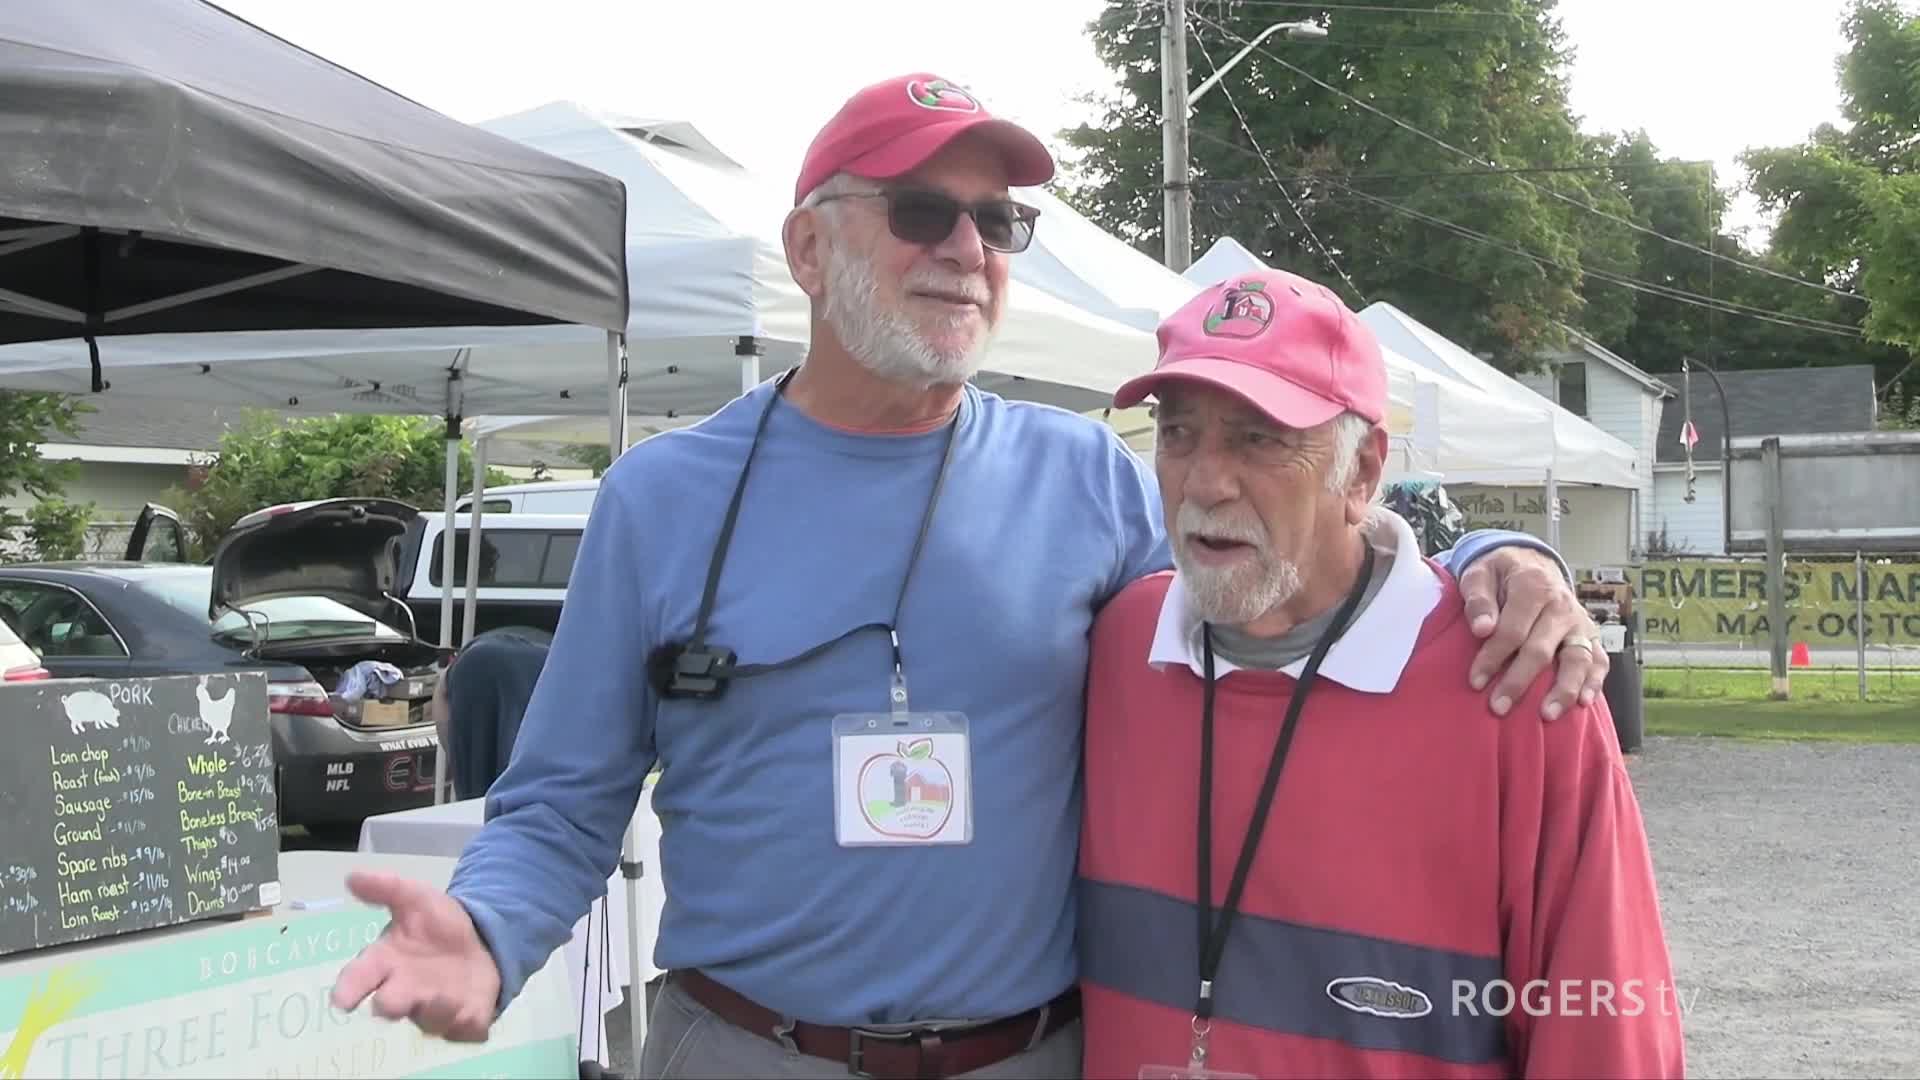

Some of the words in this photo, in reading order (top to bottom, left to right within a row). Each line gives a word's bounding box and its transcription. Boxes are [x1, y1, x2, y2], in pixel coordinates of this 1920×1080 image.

[1512, 490, 1571, 515] Laks
[1620, 567, 1812, 602] ARMERS'
[109, 682, 153, 705] PORK
[81, 742, 109, 771] chop
[326, 762, 354, 776] MLB
[52, 768, 89, 791] Roast
[326, 779, 351, 792] NFL
[54, 793, 113, 823] Sausage
[179, 808, 226, 832] Boneless
[227, 800, 264, 825] Breast
[53, 821, 103, 846] Ground
[180, 834, 218, 859] Thighs
[57, 851, 98, 880] Spare
[101, 843, 129, 871] ribs
[57, 881, 94, 907] Ham
[97, 872, 131, 899] roast
[184, 862, 222, 892] Wings
[187, 890, 226, 916] Drums
[60, 909, 89, 929] Loin
[90, 904, 121, 923] Roast
[46, 1007, 228, 1080] THREE
